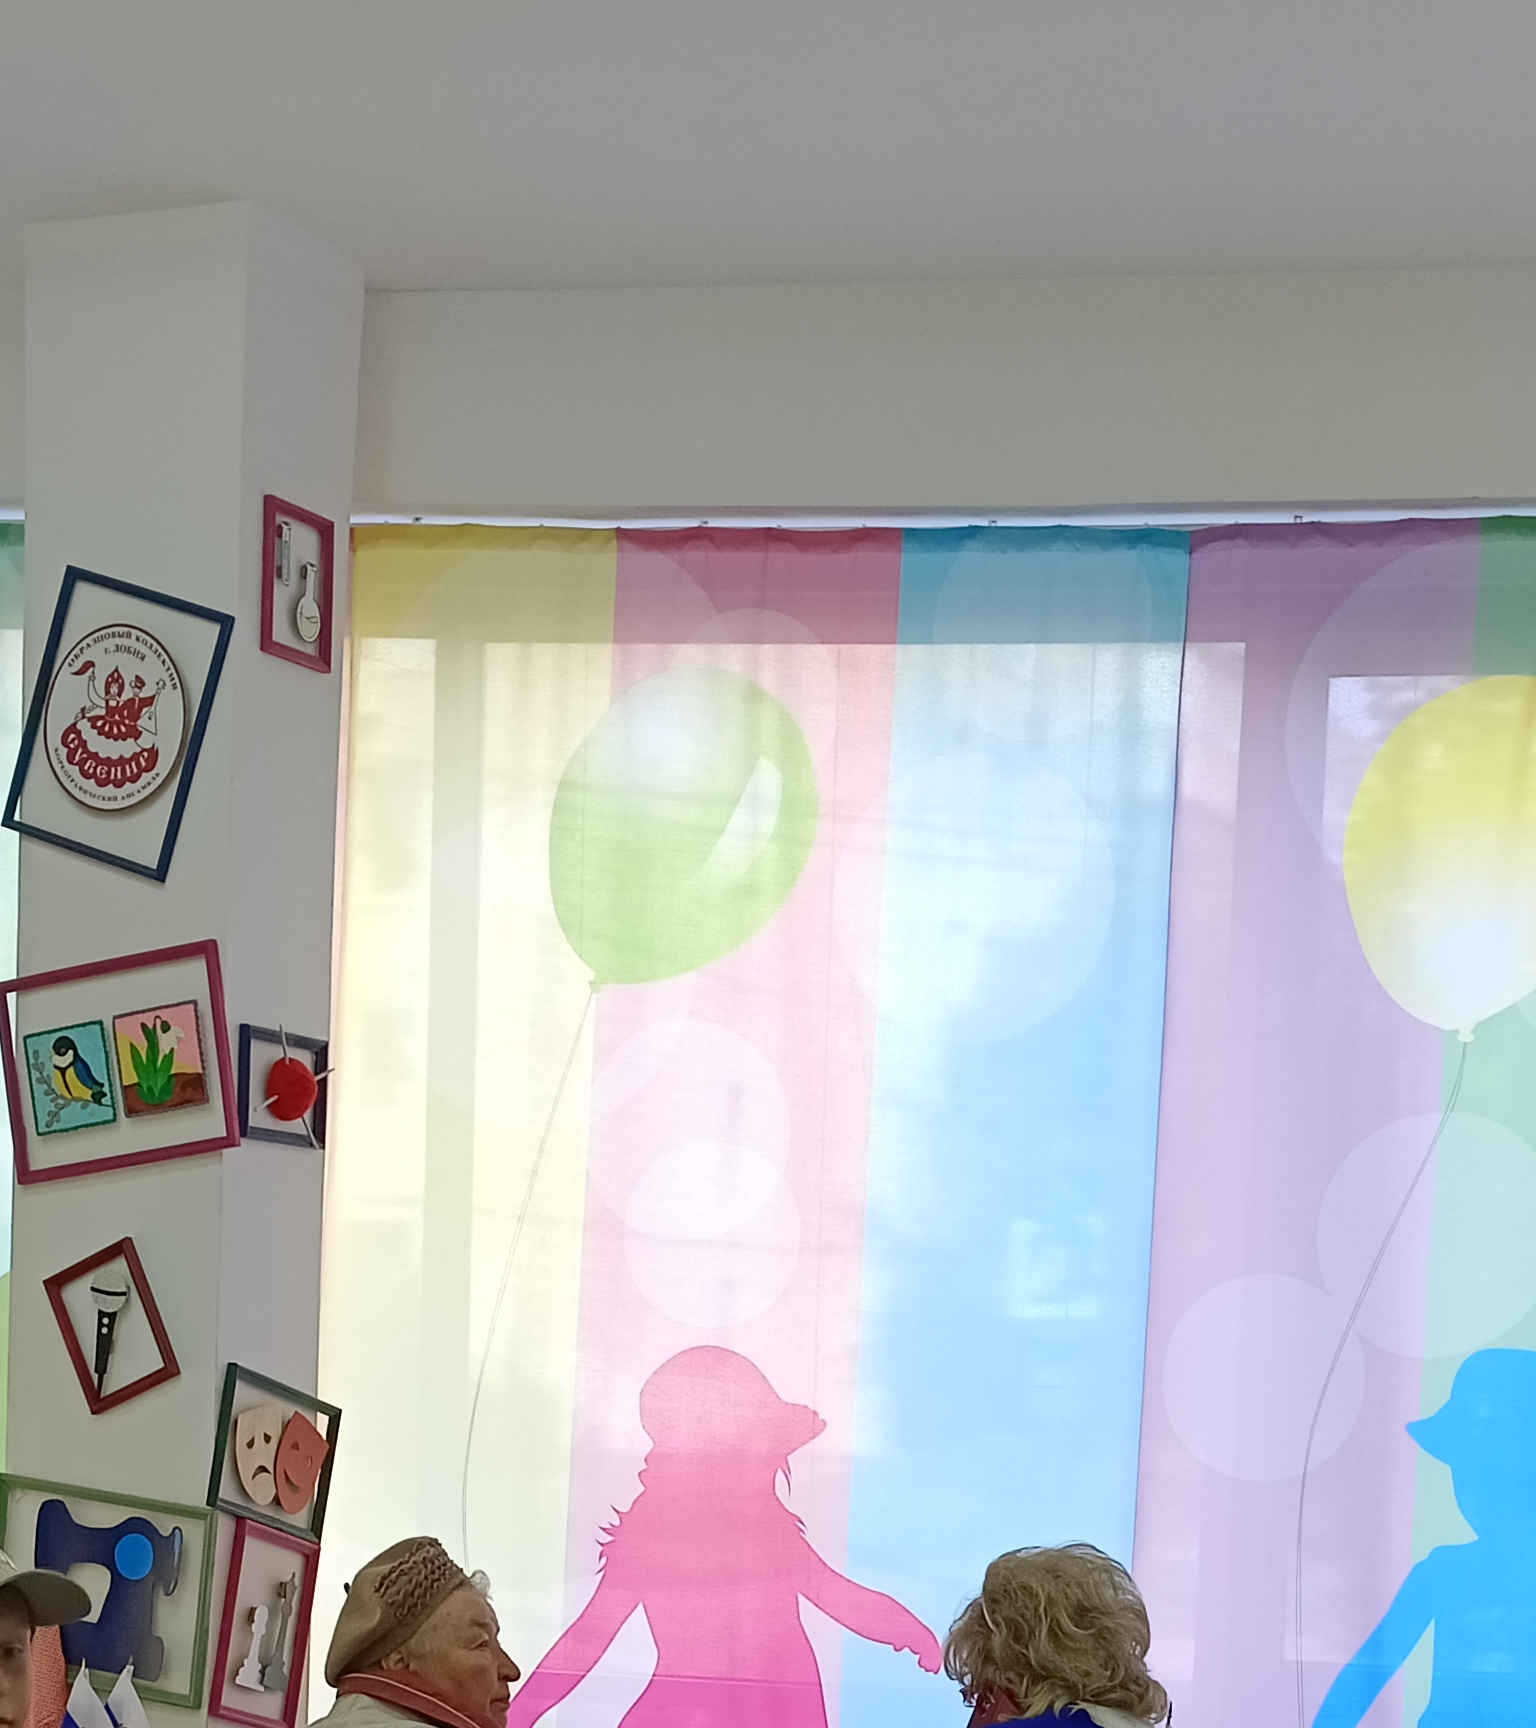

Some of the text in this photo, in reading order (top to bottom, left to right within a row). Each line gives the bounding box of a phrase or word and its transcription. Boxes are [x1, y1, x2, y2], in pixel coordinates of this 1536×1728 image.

[67, 630, 178, 691] ОБРАЗЦОВЫЙ КОЛЛЕКТИВ
[113, 643, 147, 662] ЛОБНЯ
[67, 733, 149, 780] СУВЕНИР
